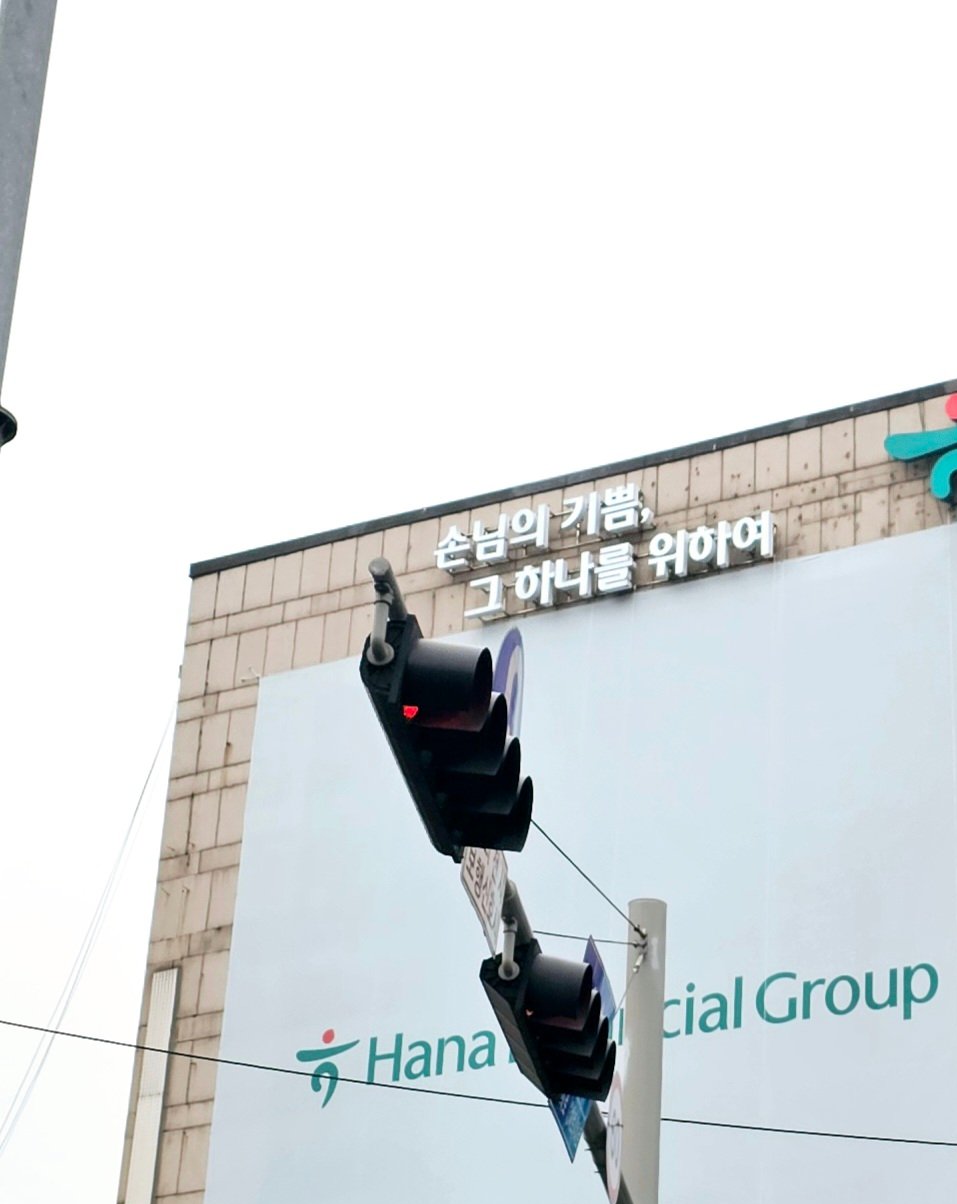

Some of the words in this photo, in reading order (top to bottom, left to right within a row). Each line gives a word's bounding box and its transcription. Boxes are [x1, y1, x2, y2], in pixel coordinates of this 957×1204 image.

[434, 503, 551, 571] 손님의
[560, 482, 654, 535] 기쁨,
[463, 573, 507, 620] 그
[515, 541, 636, 606] 하나를
[648, 510, 775, 579] 위하여
[366, 1030, 496, 1085] Hana
[755, 961, 940, 1024] Group
